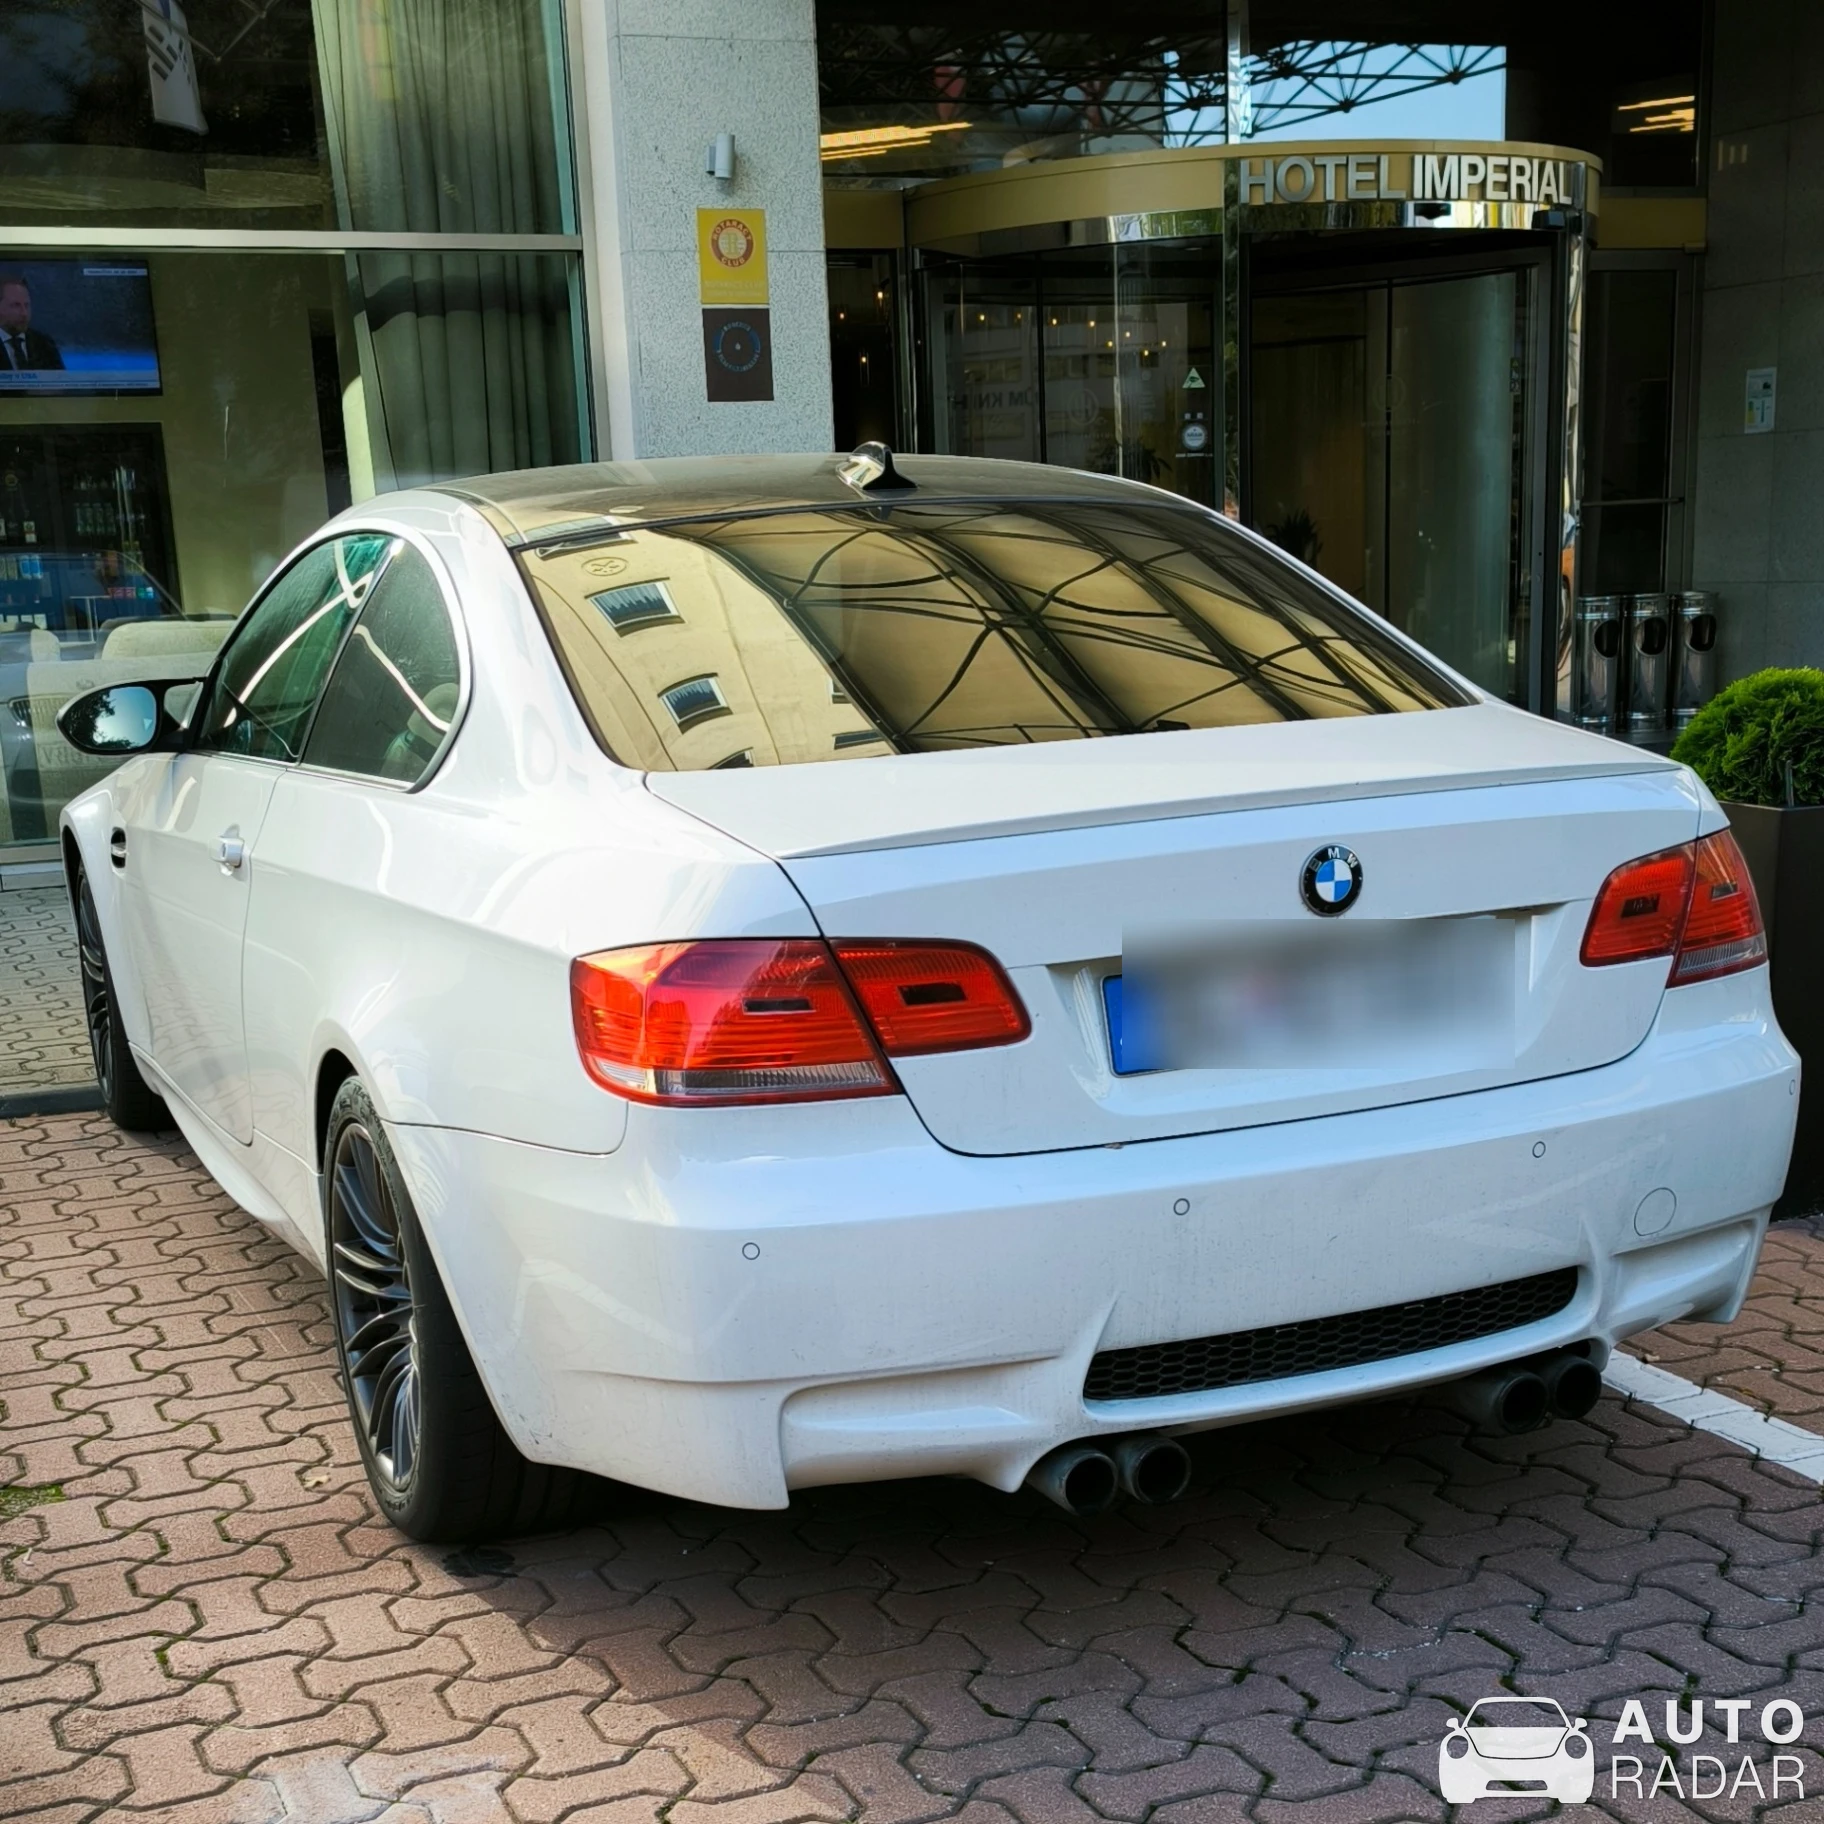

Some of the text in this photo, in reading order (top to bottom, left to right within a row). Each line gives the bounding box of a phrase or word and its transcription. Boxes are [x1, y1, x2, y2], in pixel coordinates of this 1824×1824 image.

[1239, 154, 1572, 205] HOTEL IMPERIAL
[712, 219, 752, 241] ROTARACT
[721, 255, 745, 267] CLUB
[1308, 846, 1359, 873] BMW
